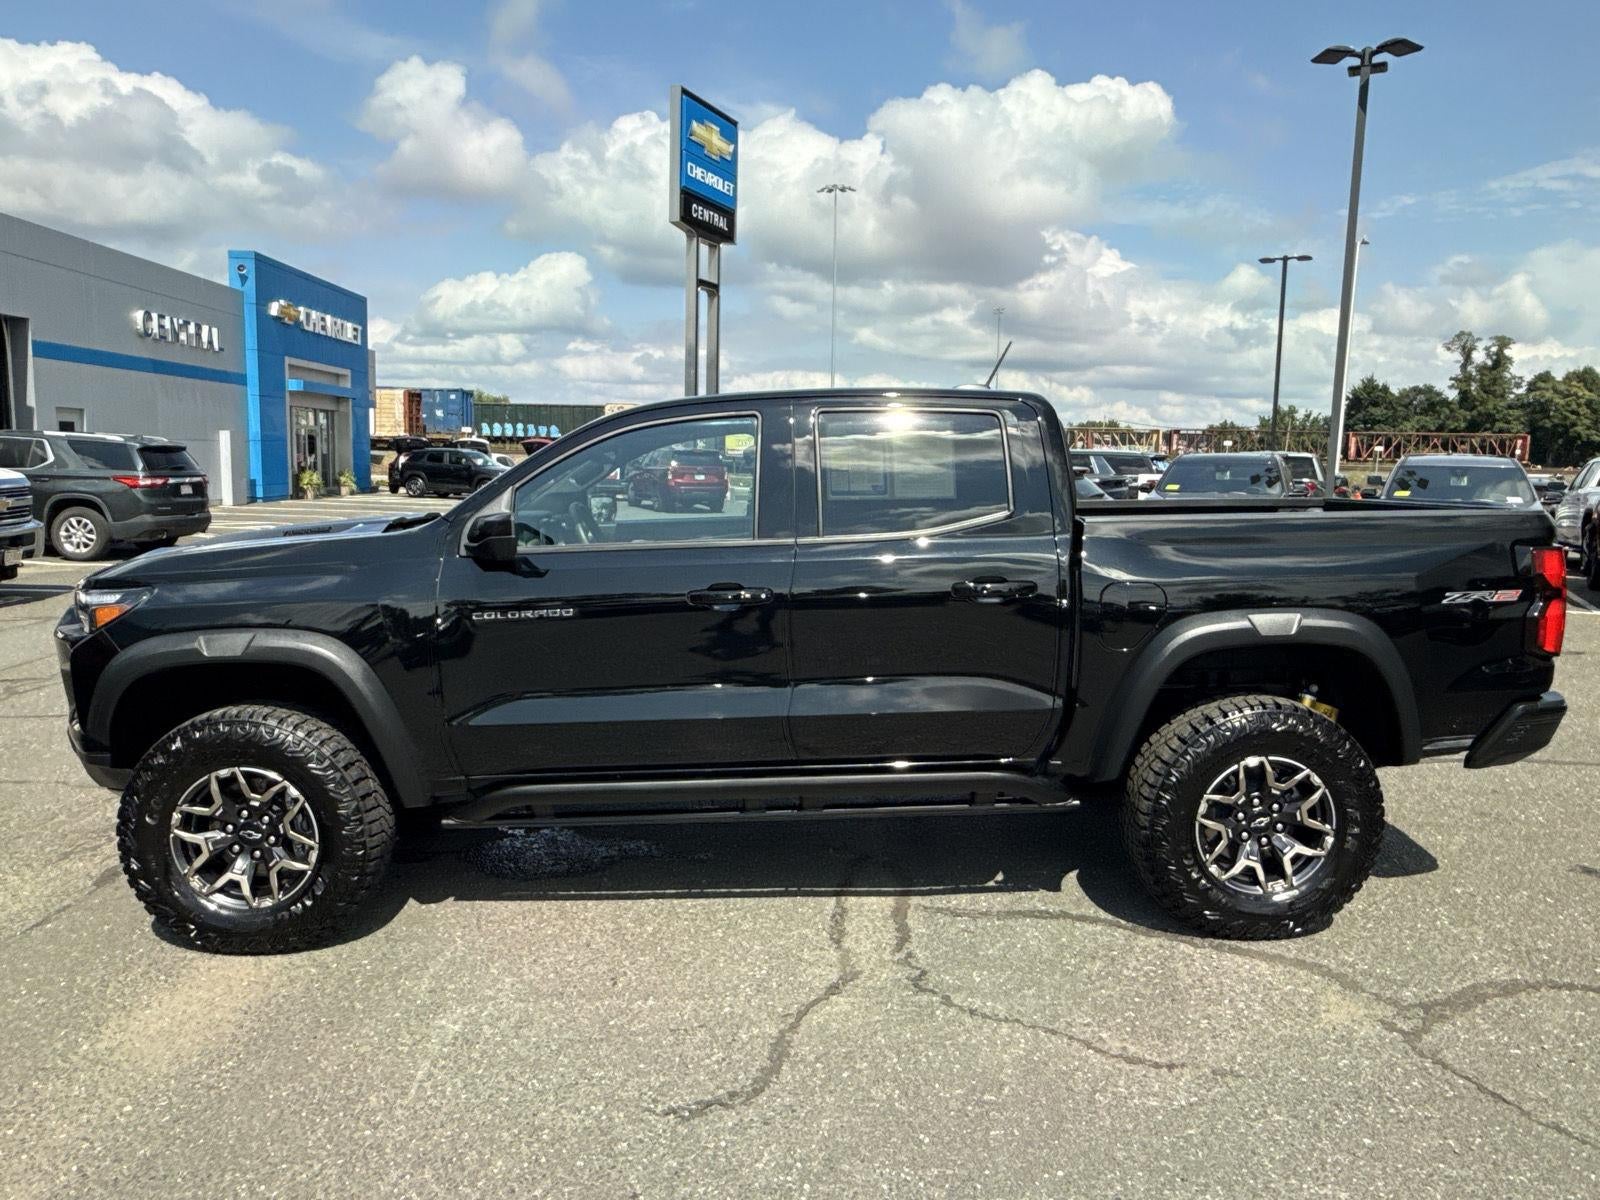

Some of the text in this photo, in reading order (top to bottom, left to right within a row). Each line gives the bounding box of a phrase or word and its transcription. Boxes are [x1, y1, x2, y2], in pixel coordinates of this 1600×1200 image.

[687, 161, 735, 197] CHEVROLET
[691, 203, 729, 231] CENTRAL
[138, 308, 225, 352] CENTRAL
[299, 306, 363, 346] CHEVROLET
[1441, 588, 1523, 604] ZR2
[471, 607, 574, 620] COLORADO
